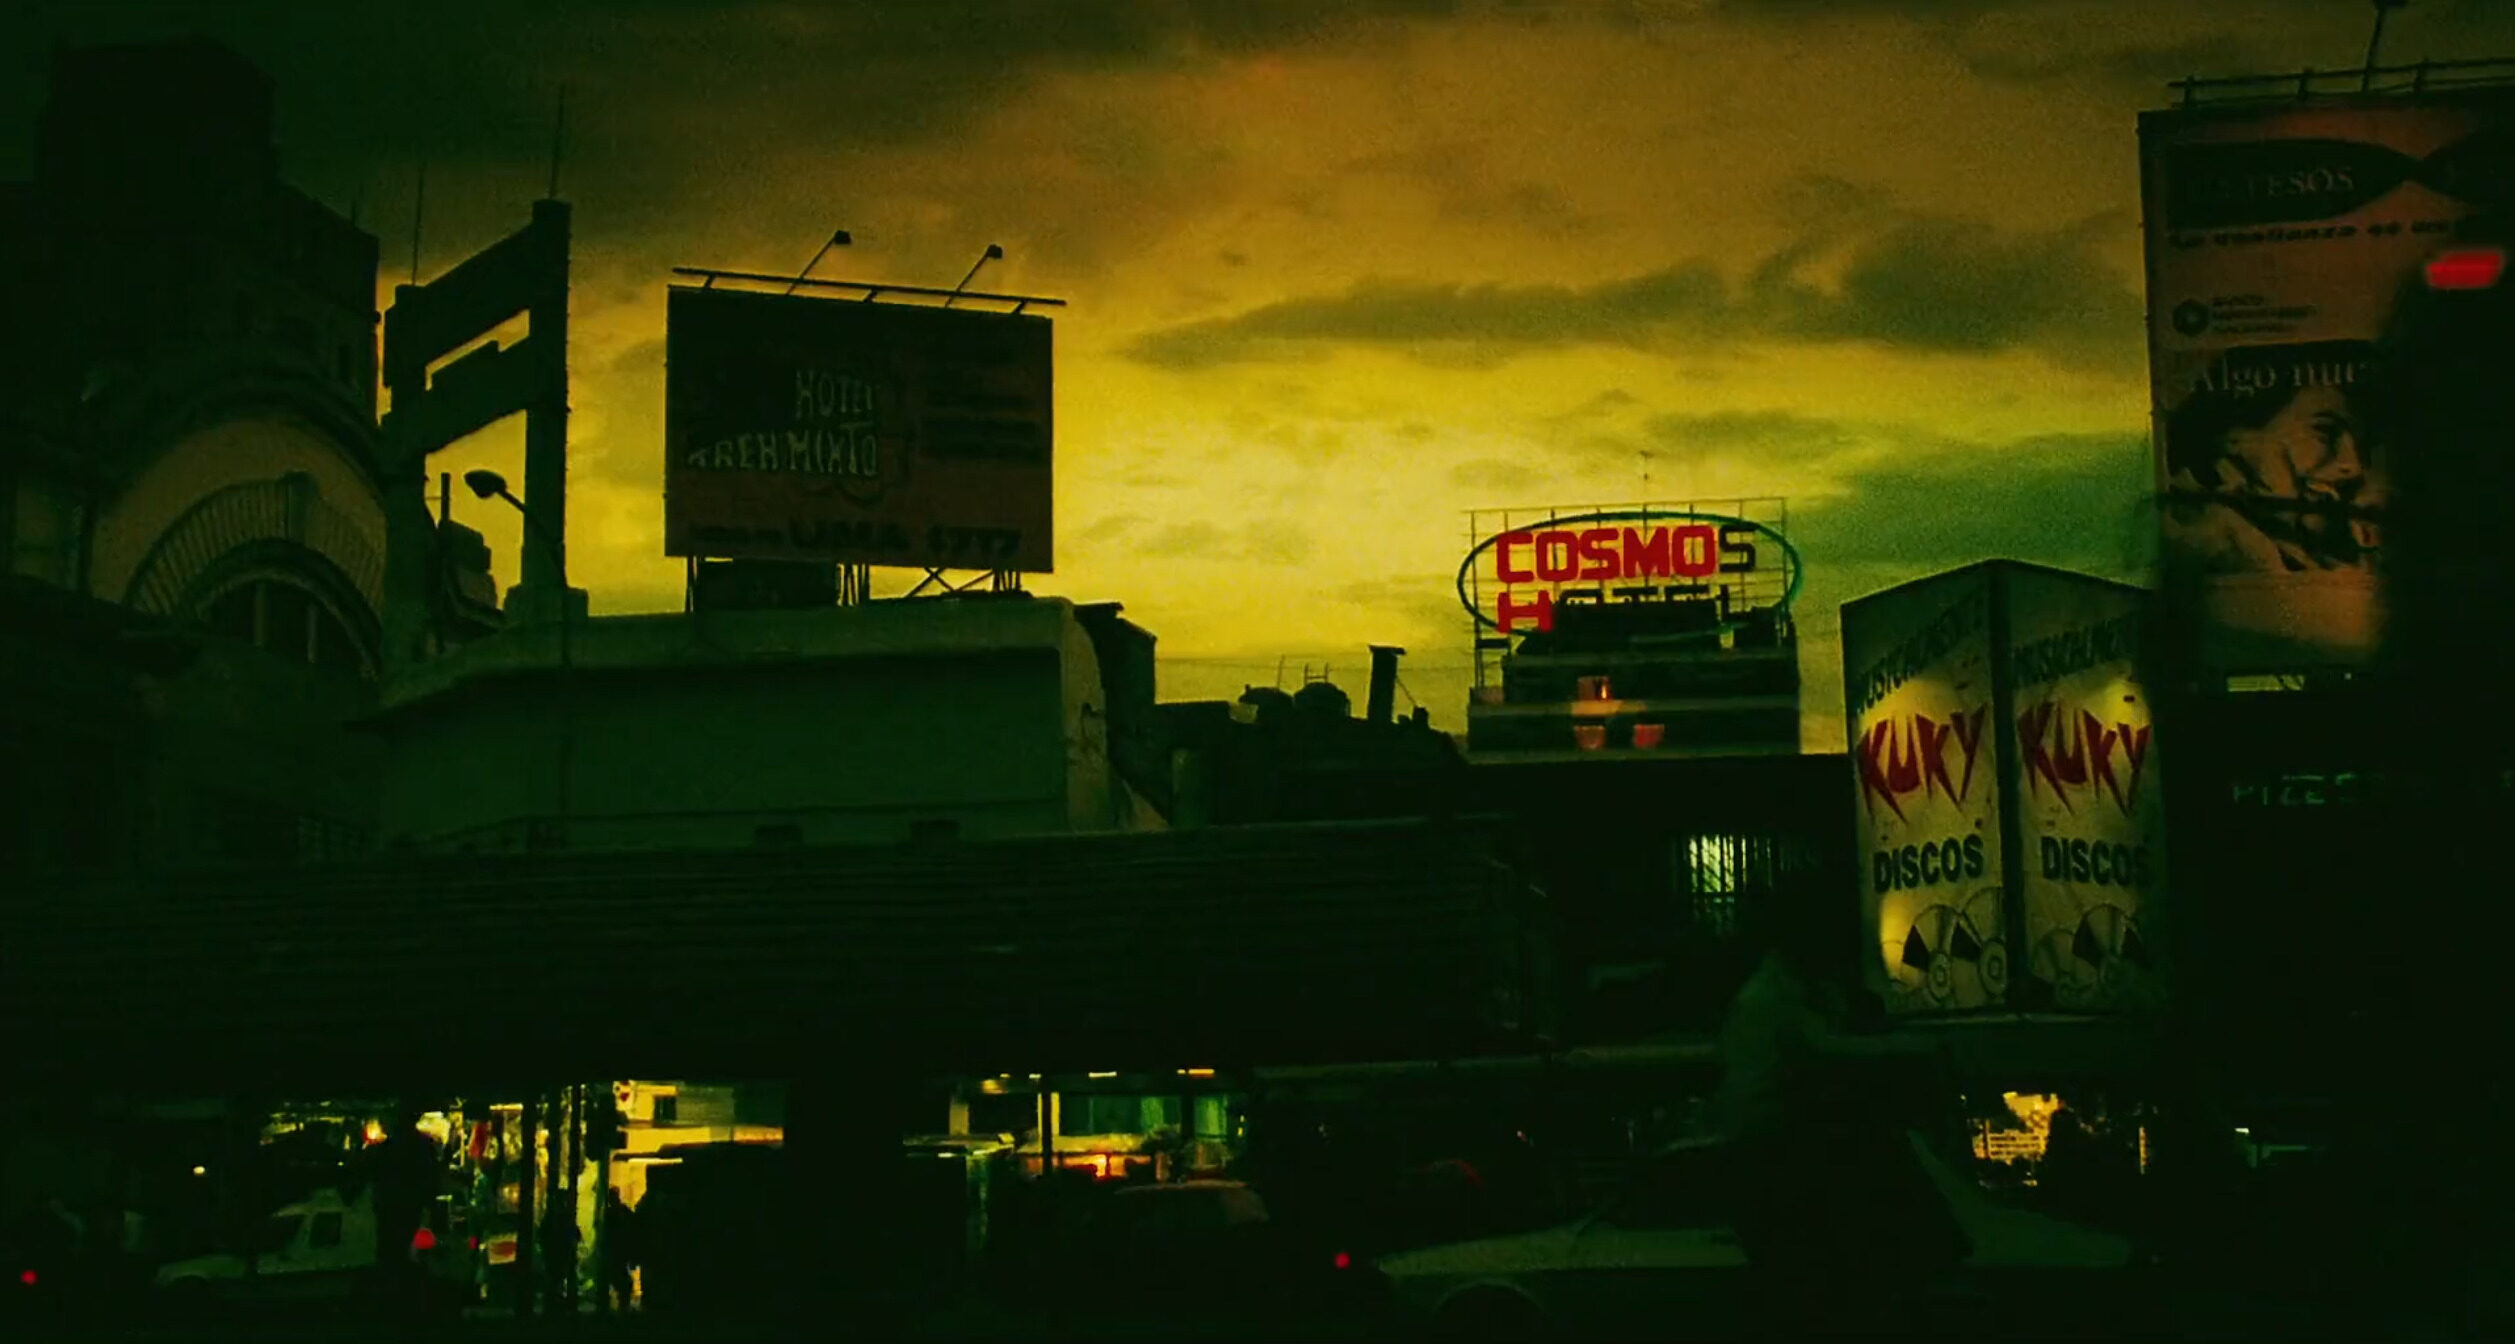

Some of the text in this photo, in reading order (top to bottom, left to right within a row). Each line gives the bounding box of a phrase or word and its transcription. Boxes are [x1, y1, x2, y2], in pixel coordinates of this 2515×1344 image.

[2190, 357, 2278, 399] Algo
[1497, 526, 1756, 583] COSMOS
[1858, 703, 1987, 825] KUKY
[2018, 702, 2152, 818] KUKY
[1873, 835, 1984, 892] DISCOS
[2041, 836, 2152, 886] DISCOS
